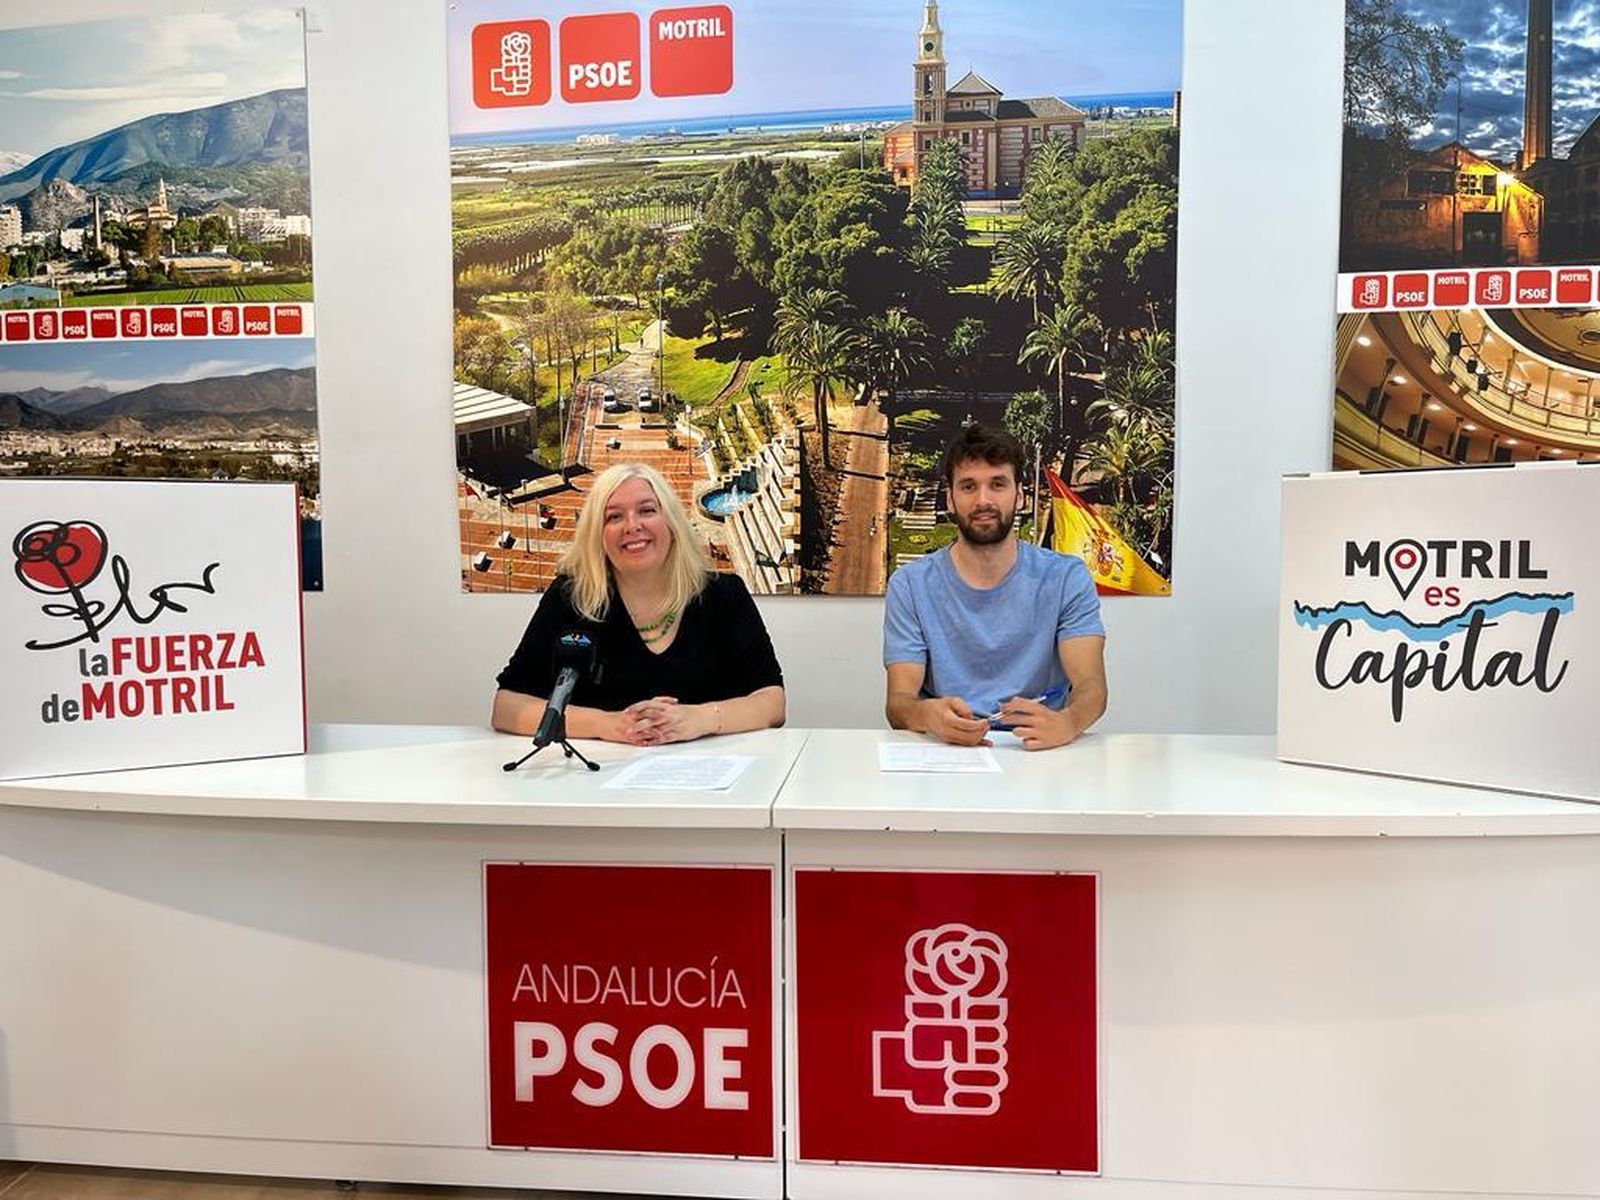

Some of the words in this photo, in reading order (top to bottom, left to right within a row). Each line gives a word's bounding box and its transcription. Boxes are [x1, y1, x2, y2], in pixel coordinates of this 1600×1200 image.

[658, 18, 725, 41] MOTRIL
[568, 60, 632, 90] PSOE
[1437, 276, 1467, 285] MOTRIL
[1396, 291, 1425, 302] PSOE
[1519, 288, 1549, 299] PSOE
[64, 325, 86, 335] PSOE
[153, 323, 176, 333] PSOE
[245, 321, 269, 332] PSOE
[1345, 539, 1548, 600] MOTRIL
[1424, 586, 1461, 607] es
[1315, 607, 1569, 723] Capital
[512, 955, 747, 1009] ANDALUCÍA
[513, 1021, 749, 1110] PSOE
